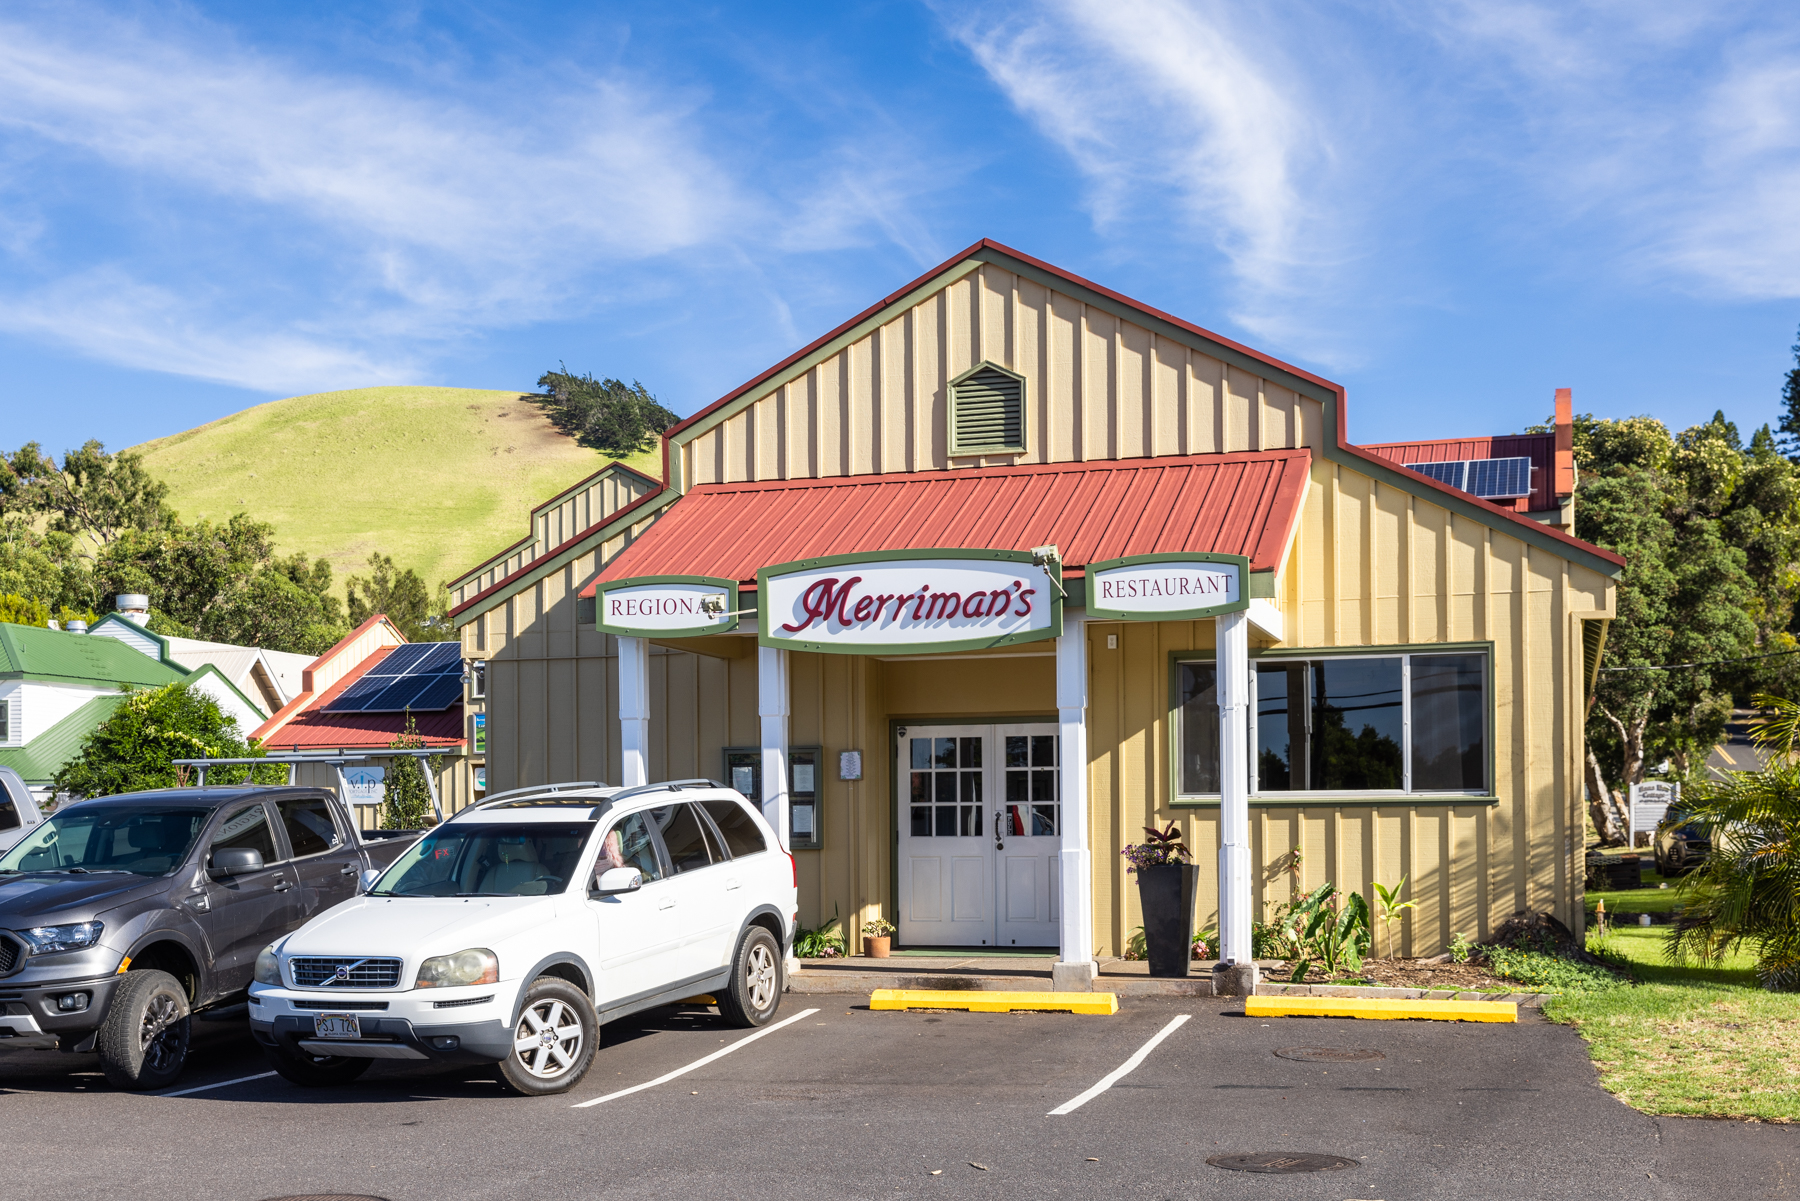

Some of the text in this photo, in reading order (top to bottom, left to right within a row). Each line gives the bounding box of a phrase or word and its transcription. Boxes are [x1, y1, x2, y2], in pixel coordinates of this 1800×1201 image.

[1102, 574, 1233, 599] RESTAURANT
[611, 597, 723, 616] REGION
[781, 576, 1037, 632] Merriman's
